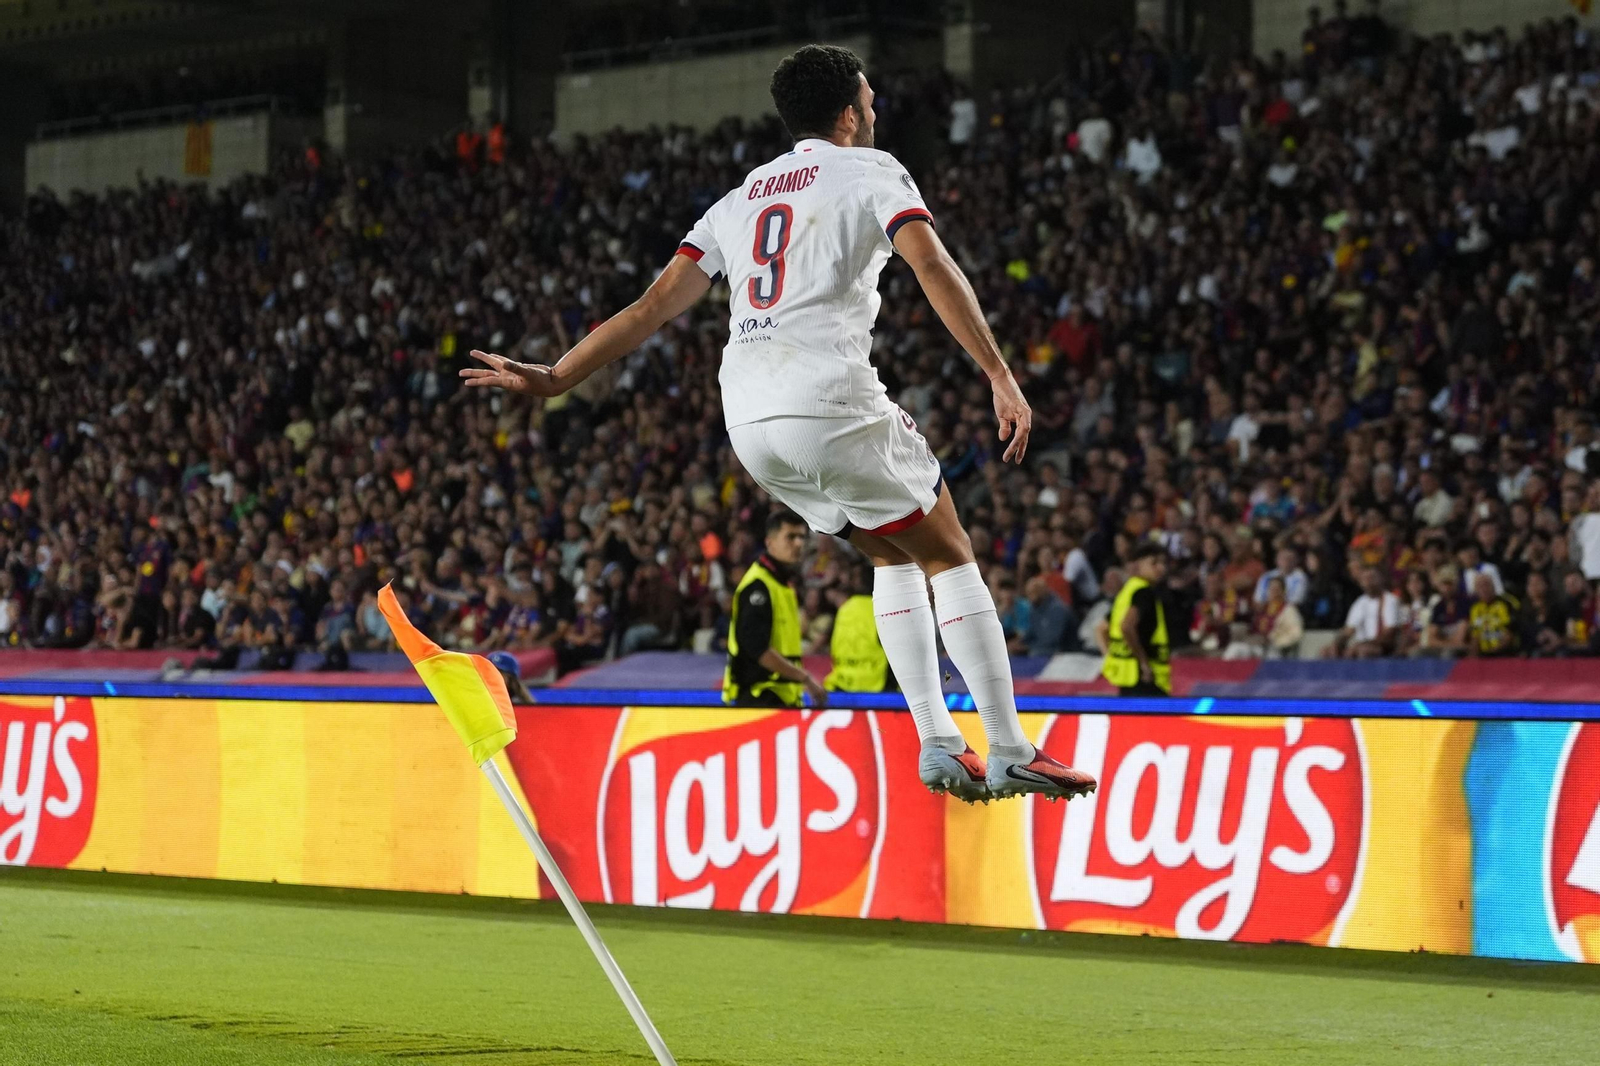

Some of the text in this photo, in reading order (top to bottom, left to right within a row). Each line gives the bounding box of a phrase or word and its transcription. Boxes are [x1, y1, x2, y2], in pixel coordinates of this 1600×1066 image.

[748, 165, 819, 200] G.RAMOS
[748, 203, 793, 310] 9
[0, 695, 89, 866] y's
[1051, 715, 1346, 941] Lay's
